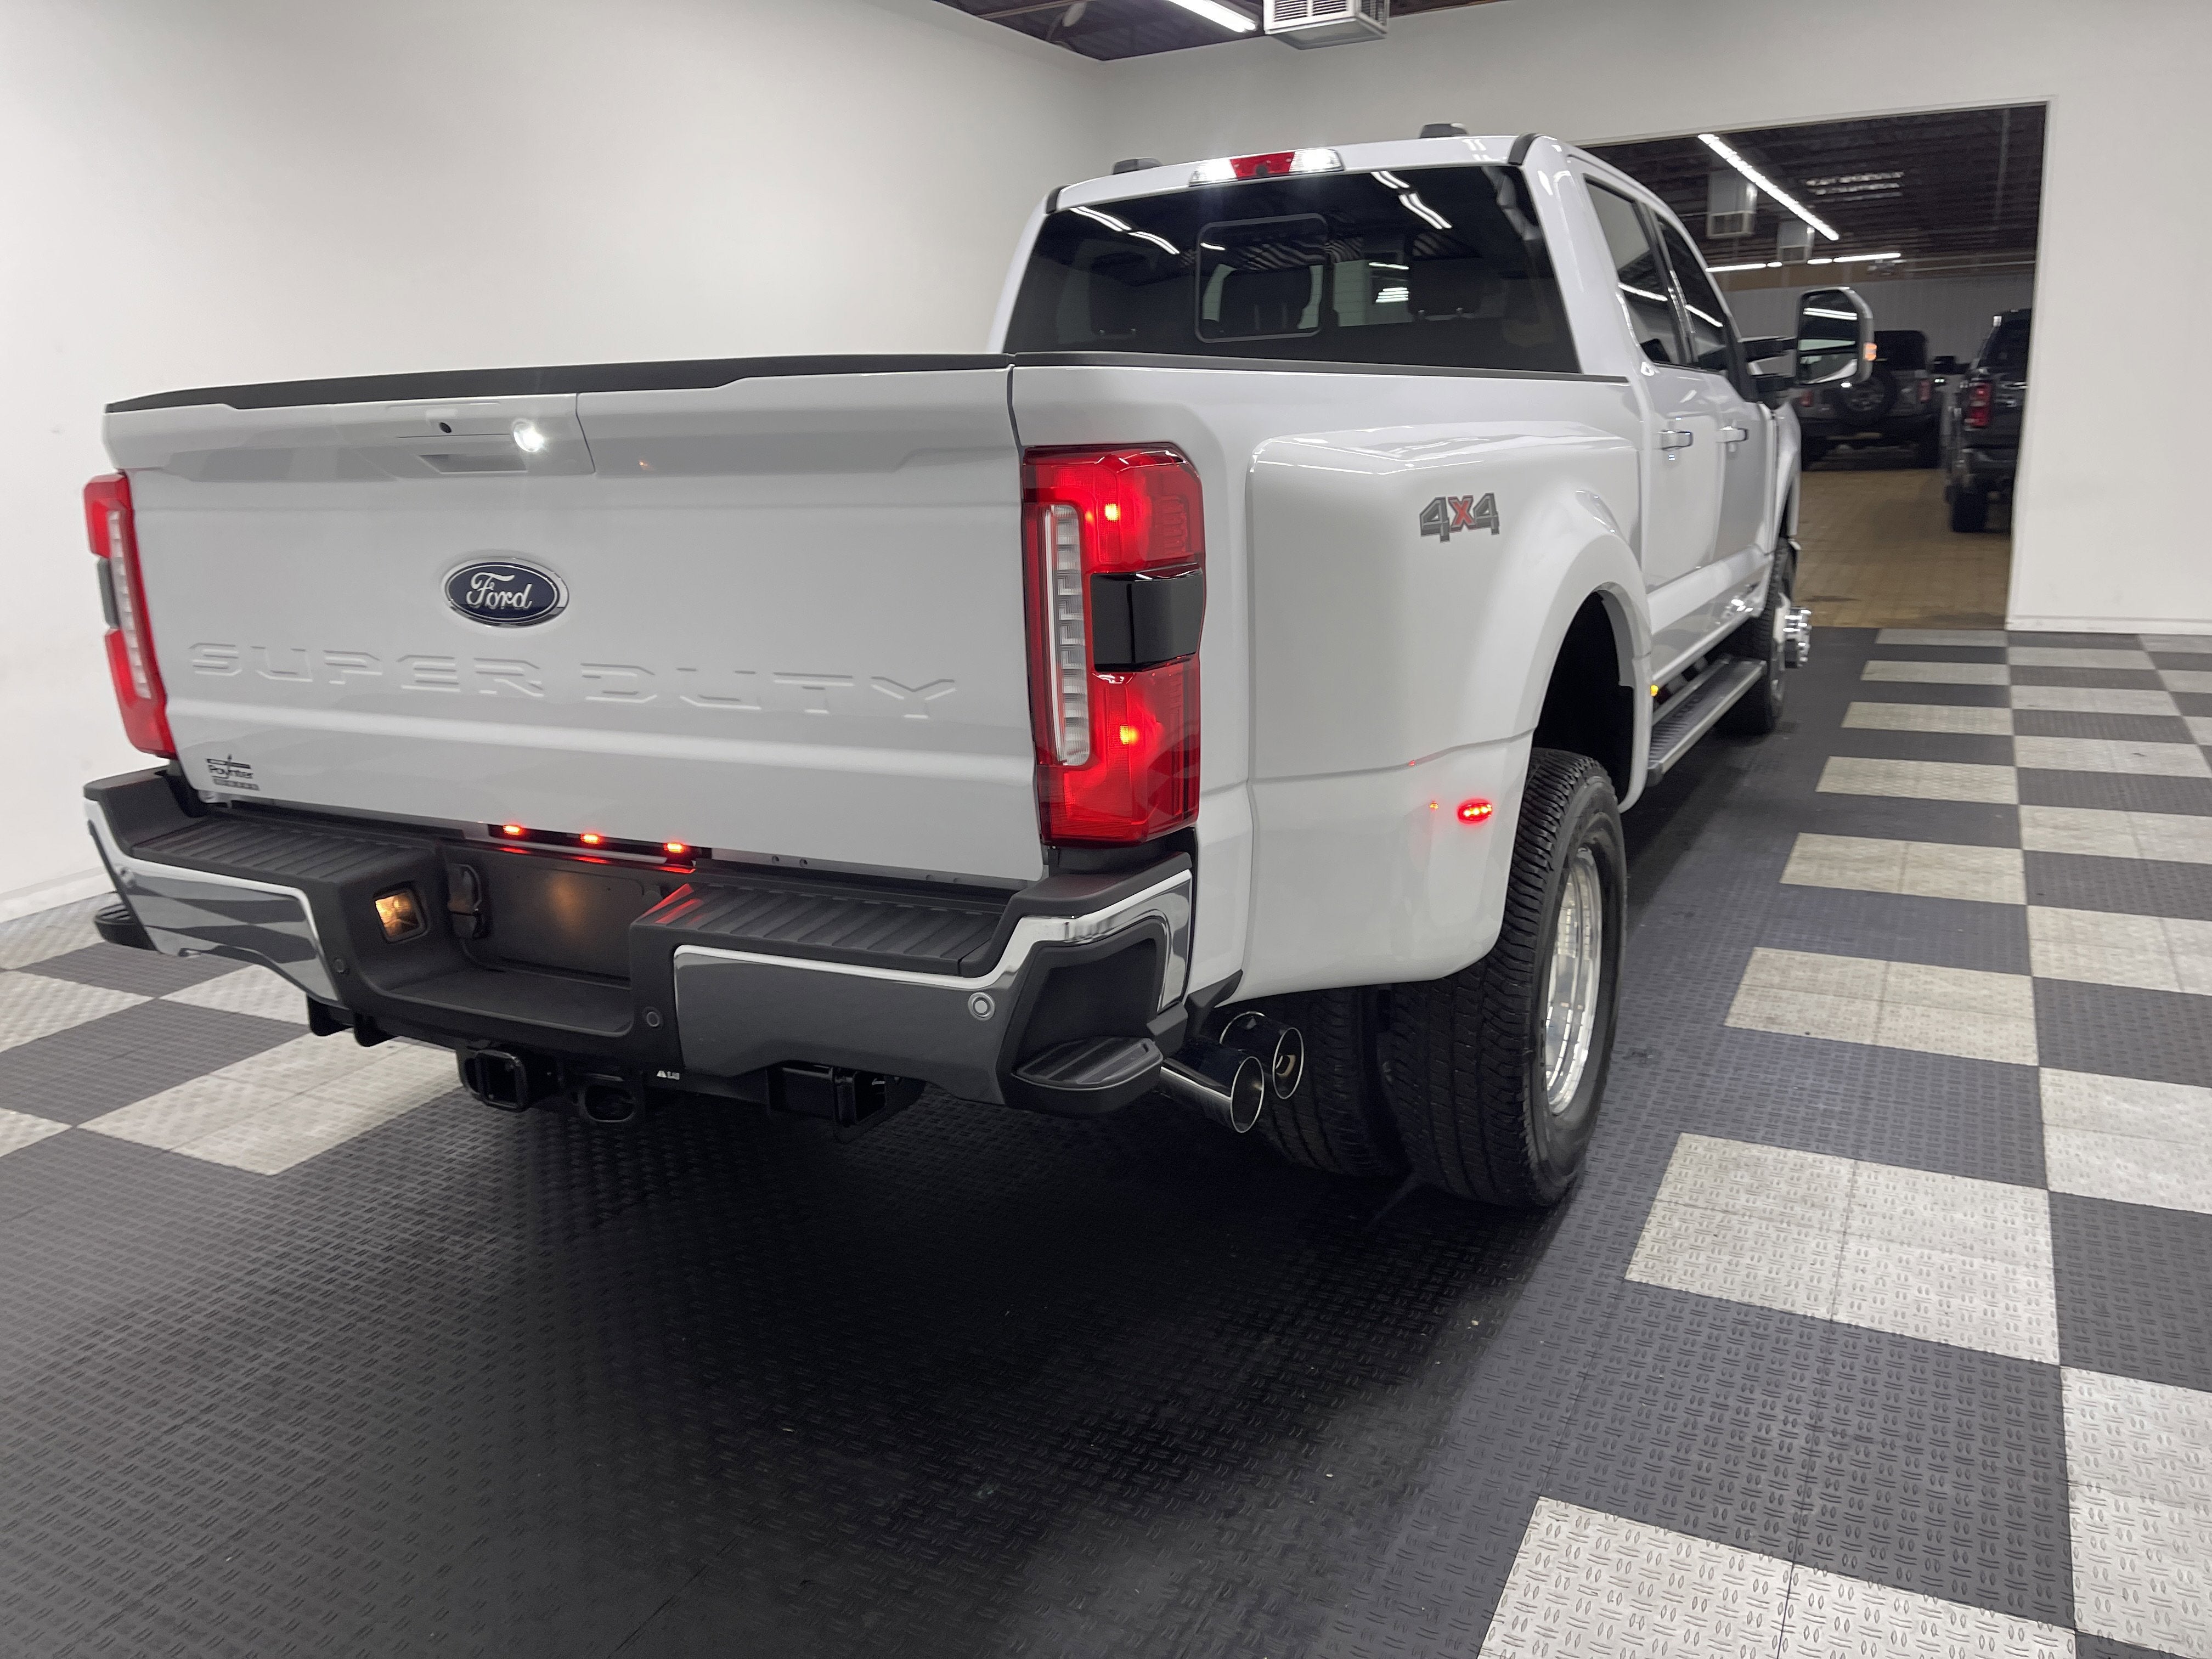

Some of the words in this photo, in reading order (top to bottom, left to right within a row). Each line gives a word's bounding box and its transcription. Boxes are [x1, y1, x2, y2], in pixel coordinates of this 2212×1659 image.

[466, 572, 532, 610] Ford
[188, 642, 545, 697] SUPER
[580, 662, 956, 718] DUTY
